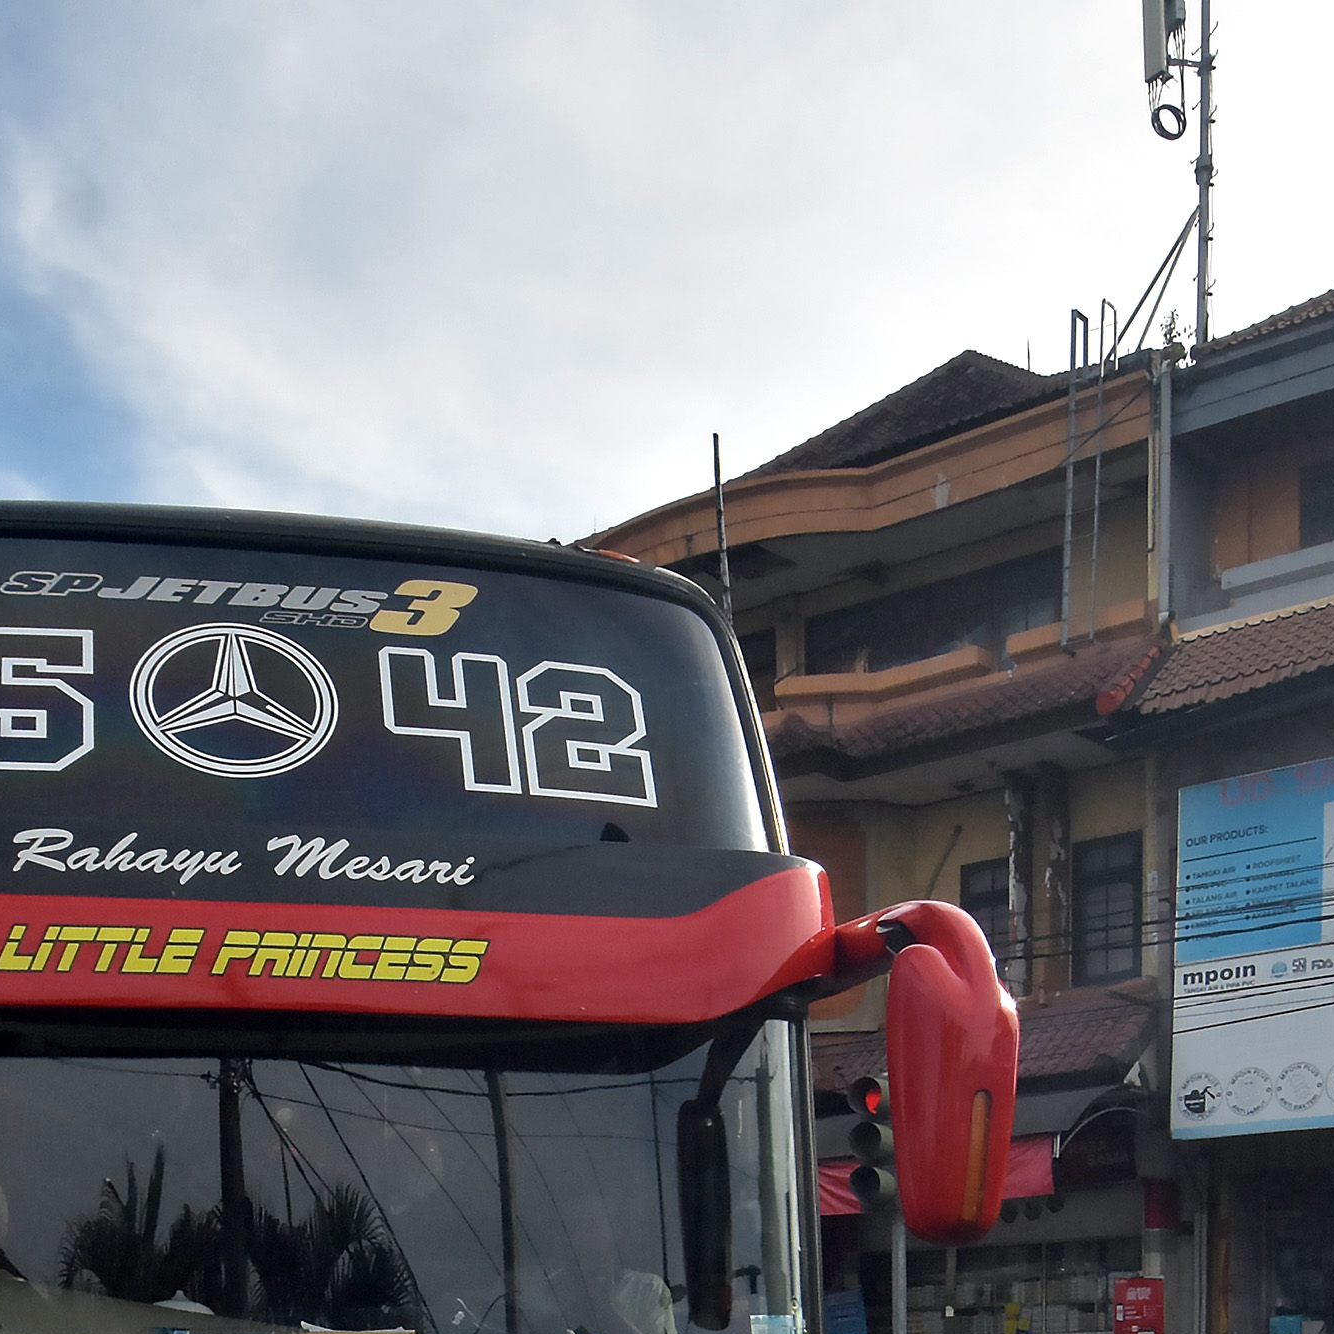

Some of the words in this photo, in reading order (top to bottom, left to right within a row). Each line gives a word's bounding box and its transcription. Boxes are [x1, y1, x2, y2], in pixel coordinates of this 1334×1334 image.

[259, 611, 369, 629] SHD
[379, 646, 658, 808] 42
[1186, 836, 1207, 847] OUR
[1209, 825, 1268, 843] PRODUCTS:
[12, 828, 241, 884] Rahayu
[267, 834, 475, 886] Mesari
[1222, 866, 1236, 875] AIR
[1252, 883, 1283, 895] KARPET
[1286, 878, 1319, 890] TALANG
[1192, 894, 1222, 904] TALANG
[1224, 891, 1238, 900] AIR
[210, 929, 490, 984] PRINCESS
[1183, 963, 1256, 986] mpoin
[1242, 979, 1255, 988] PVC
